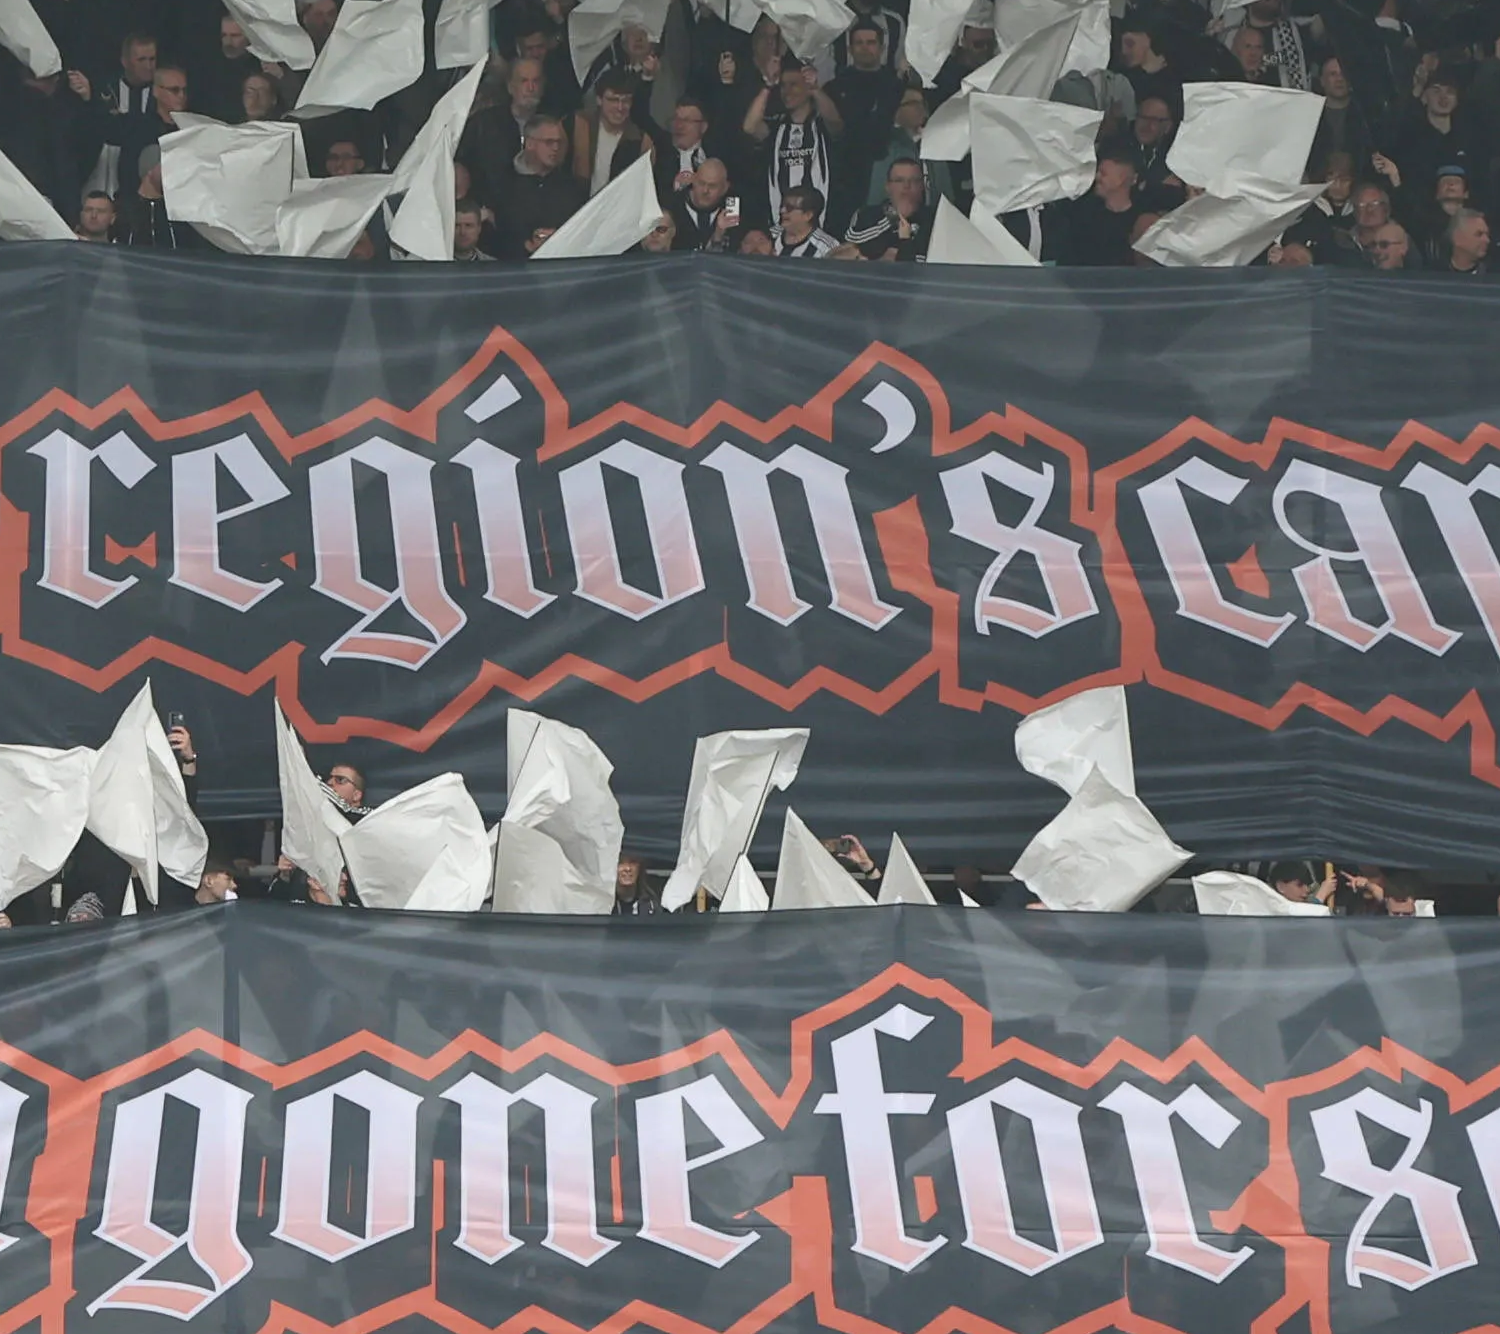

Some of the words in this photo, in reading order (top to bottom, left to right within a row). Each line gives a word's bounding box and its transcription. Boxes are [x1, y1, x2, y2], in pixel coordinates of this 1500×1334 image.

[1262, 51, 1284, 65] sel
[24, 373, 1100, 668] region's
[86, 1067, 762, 1319] gone
[812, 1002, 1255, 1283] for
